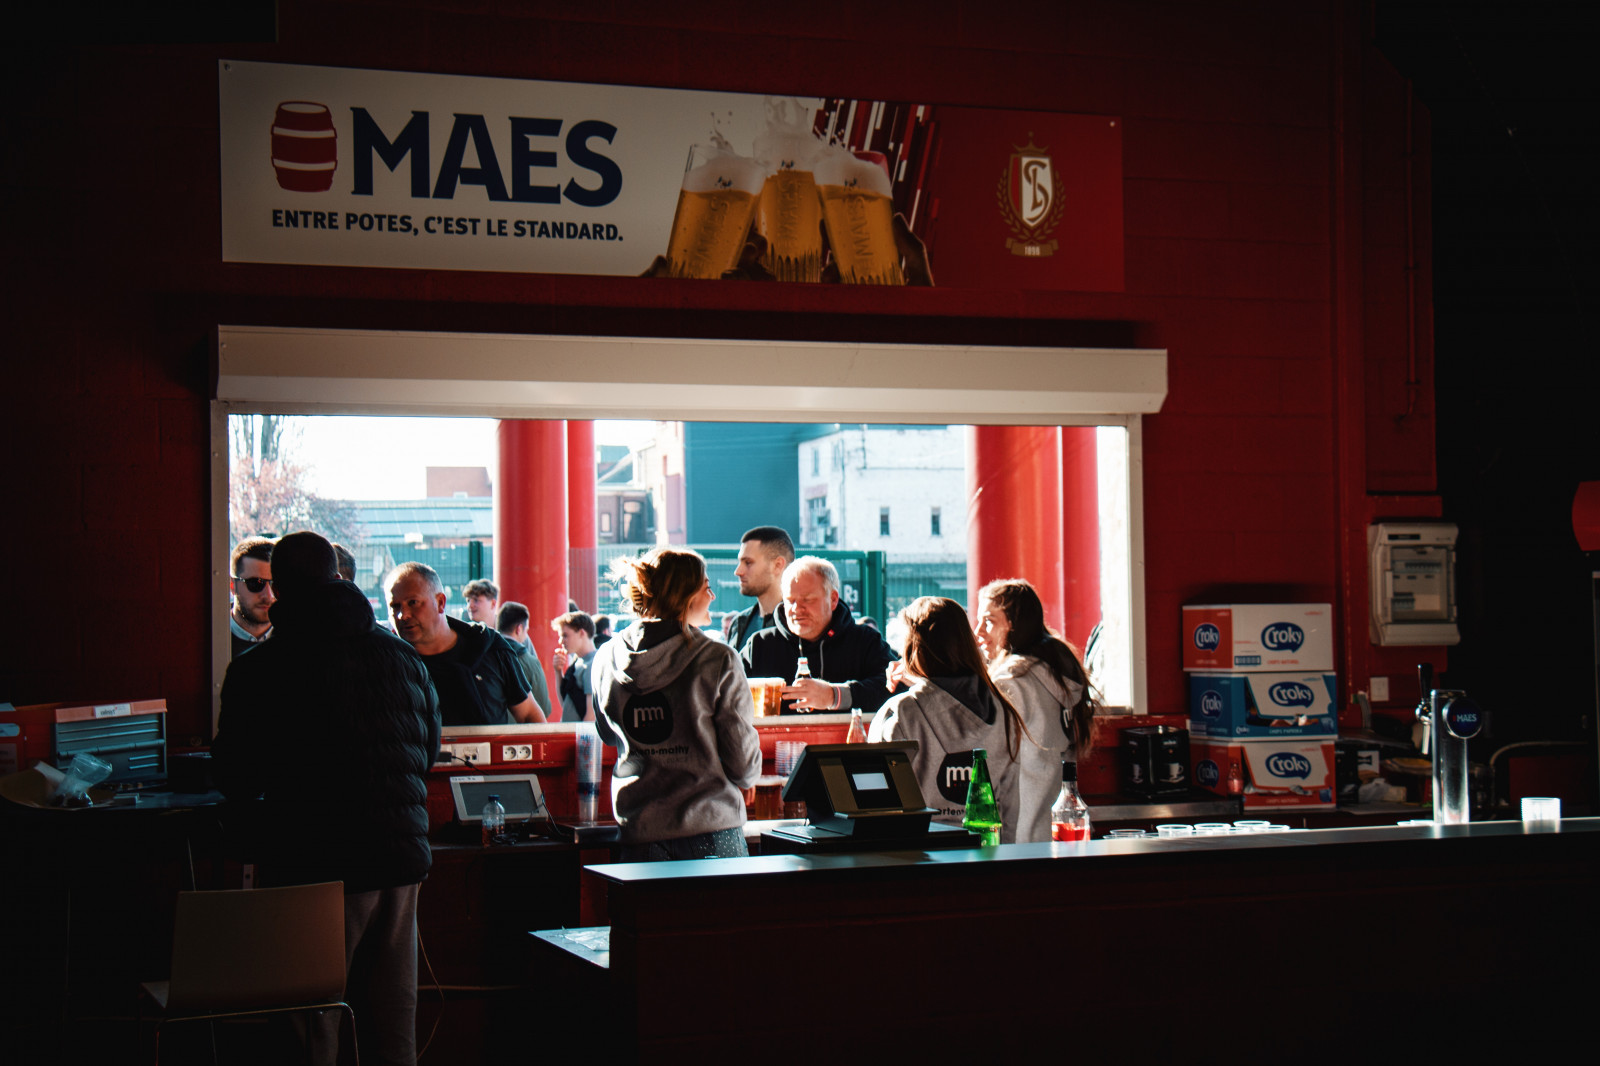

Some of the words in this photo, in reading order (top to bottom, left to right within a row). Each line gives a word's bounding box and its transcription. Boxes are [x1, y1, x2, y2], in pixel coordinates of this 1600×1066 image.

[350, 107, 623, 207] MAES
[272, 209, 339, 229] ENTRE
[345, 213, 419, 235] POTES,
[424, 217, 480, 235] C’EST
[486, 220, 508, 236] LE
[513, 221, 623, 241] STANDARD.
[1195, 627, 1219, 648] Croky
[1264, 626, 1302, 649] Croky
[1201, 694, 1222, 715] Croky
[1272, 684, 1313, 705] Croky
[1456, 713, 1478, 723] MAES
[1197, 763, 1219, 784] Croky
[1269, 755, 1309, 777] Croky
